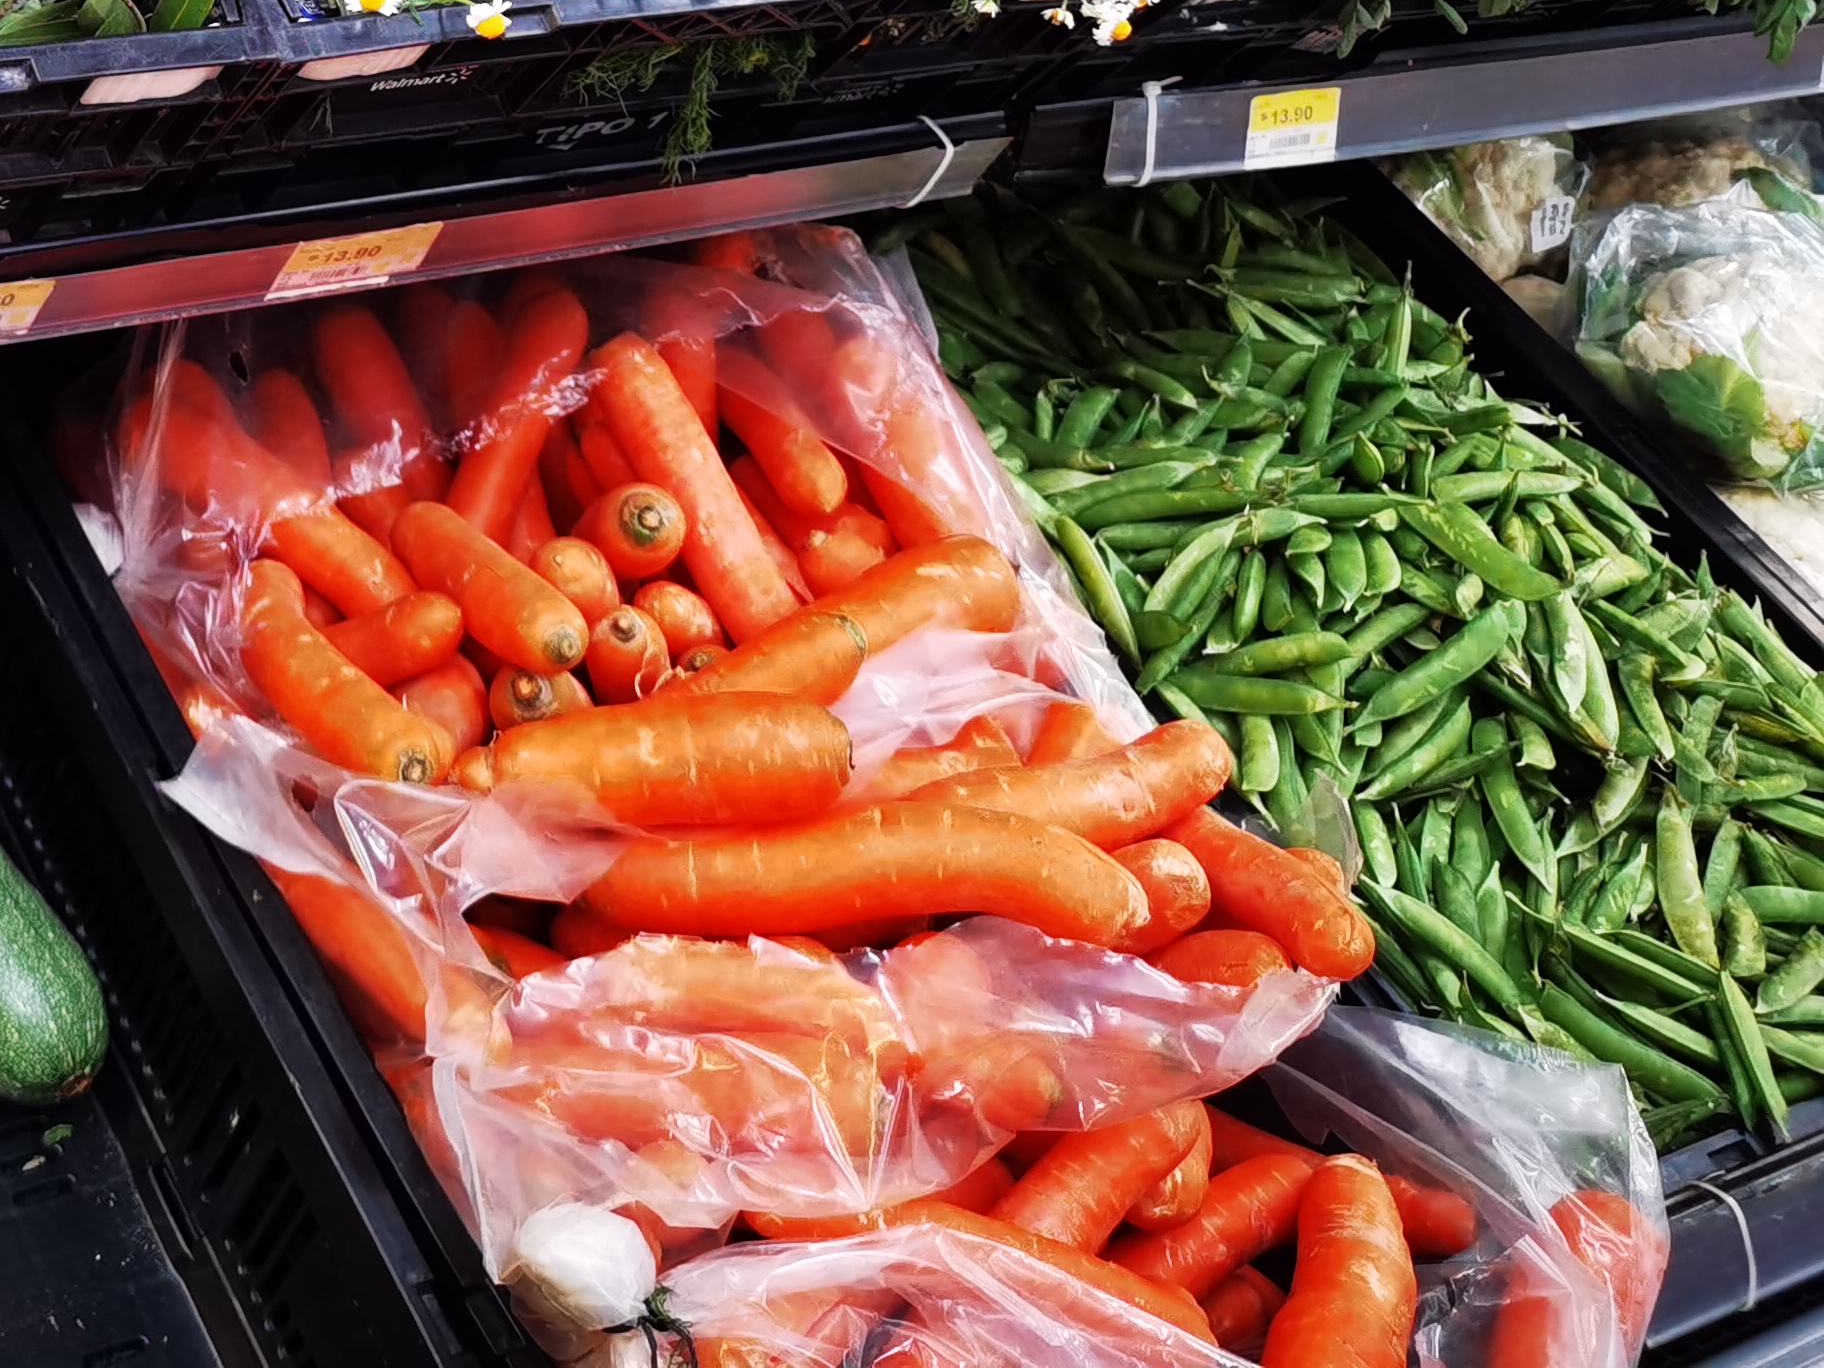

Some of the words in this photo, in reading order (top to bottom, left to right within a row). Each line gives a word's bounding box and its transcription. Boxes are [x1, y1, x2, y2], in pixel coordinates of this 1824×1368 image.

[369, 73, 446, 93] Walmart
[1271, 105, 1314, 126] 13.90
[534, 117, 636, 146] TIPO
[647, 110, 670, 130] 1
